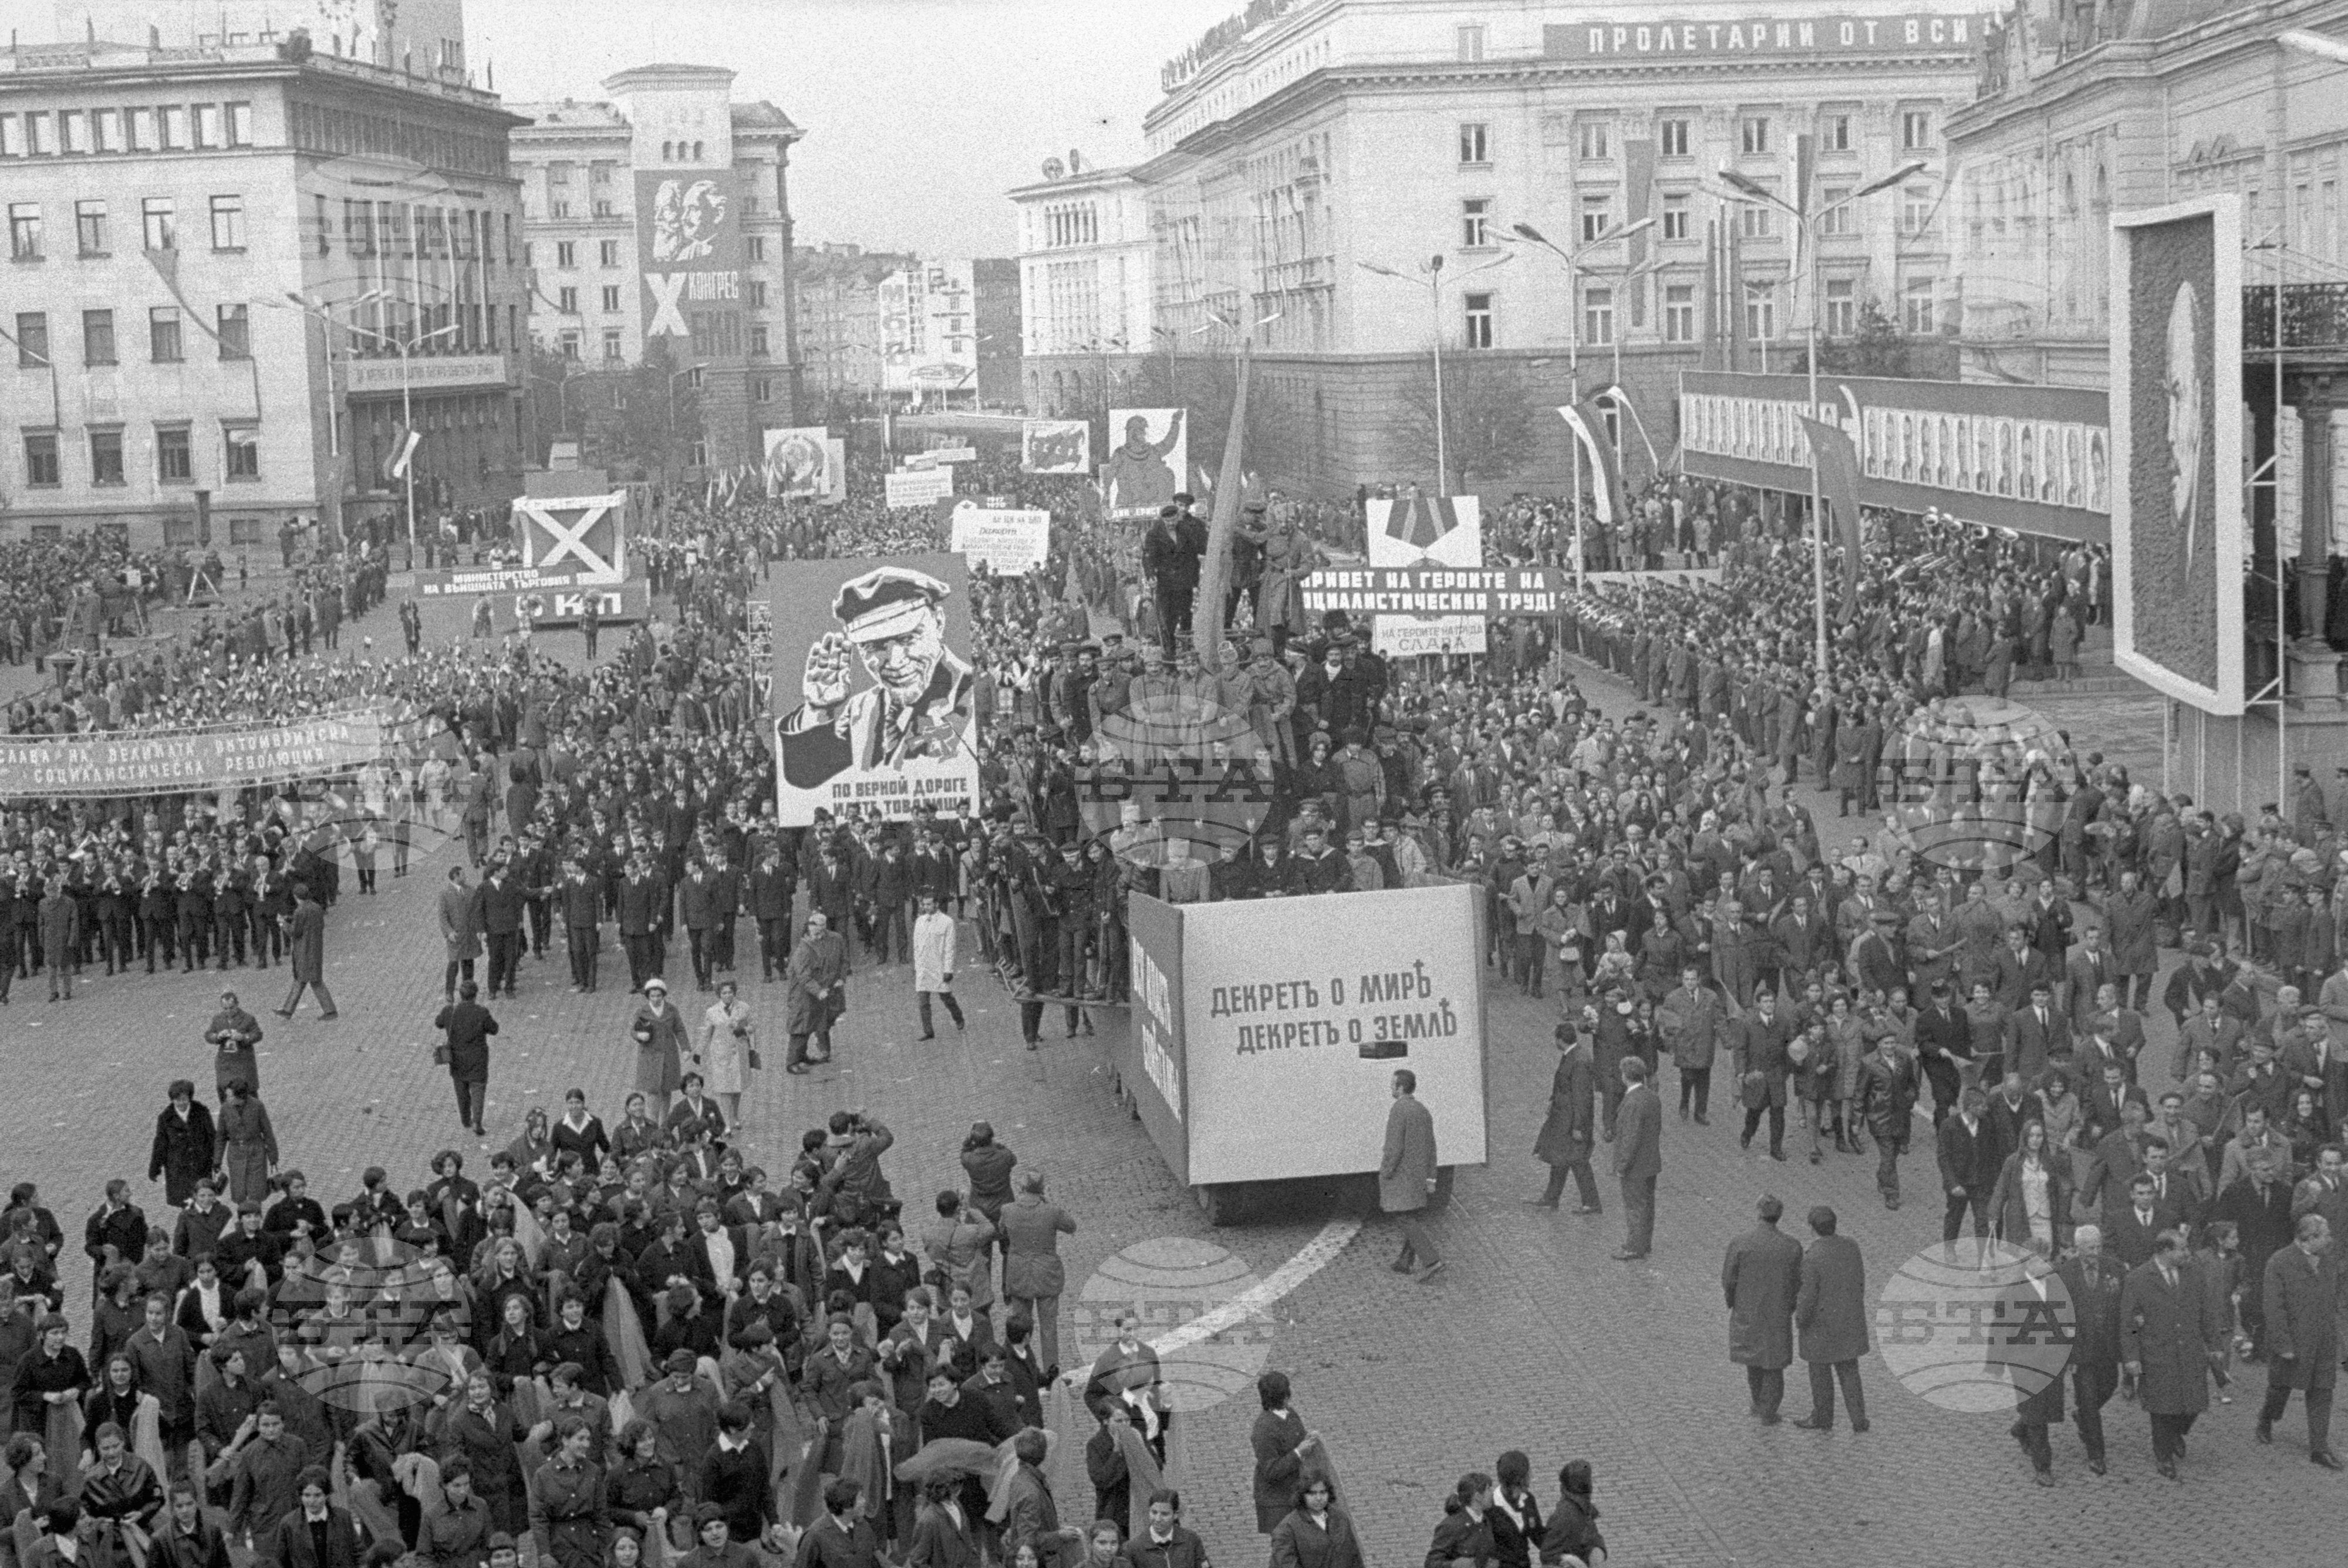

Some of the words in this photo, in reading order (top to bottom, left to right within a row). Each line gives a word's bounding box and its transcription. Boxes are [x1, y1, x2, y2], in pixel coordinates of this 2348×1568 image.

[1588, 21, 1815, 53] ПРОЛЕТАРИИ
[1840, 19, 1878, 46] ОТ
[688, 271, 739, 300] КОНГРЕС
[423, 583, 440, 594] НА
[444, 579, 507, 594] ВЪНШНАТА
[512, 575, 570, 589] ТЪРГОВИЯ
[453, 569, 539, 583] МИНИСТЕРСТВО
[1386, 572, 1411, 589] НА
[1419, 571, 1506, 589] ГЕРОИТЕ
[1520, 572, 1545, 589] НА
[1302, 592, 1487, 611] ОЦИАЛИСТИЧЕСКИЯ
[1497, 593, 1556, 613] ТРУД!
[68, 748, 88, 763] НА
[109, 741, 195, 763] ВЕЛИКАТА
[34, 760, 204, 785] СОЦИАЛИСТИЧЕСКА
[225, 748, 325, 772] РЕВОЛЮЦИЯ
[832, 783, 851, 798] ПО
[855, 776, 909, 797] ВЕРНОЙ
[913, 778, 968, 796] ДОРОГЕ
[1210, 979, 1319, 1019] ДЕКРЕТЪ
[1330, 977, 1345, 1005] О
[1237, 1018, 1341, 1055] ДЕКРЕТЪ
[1348, 1016, 1363, 1044] О
